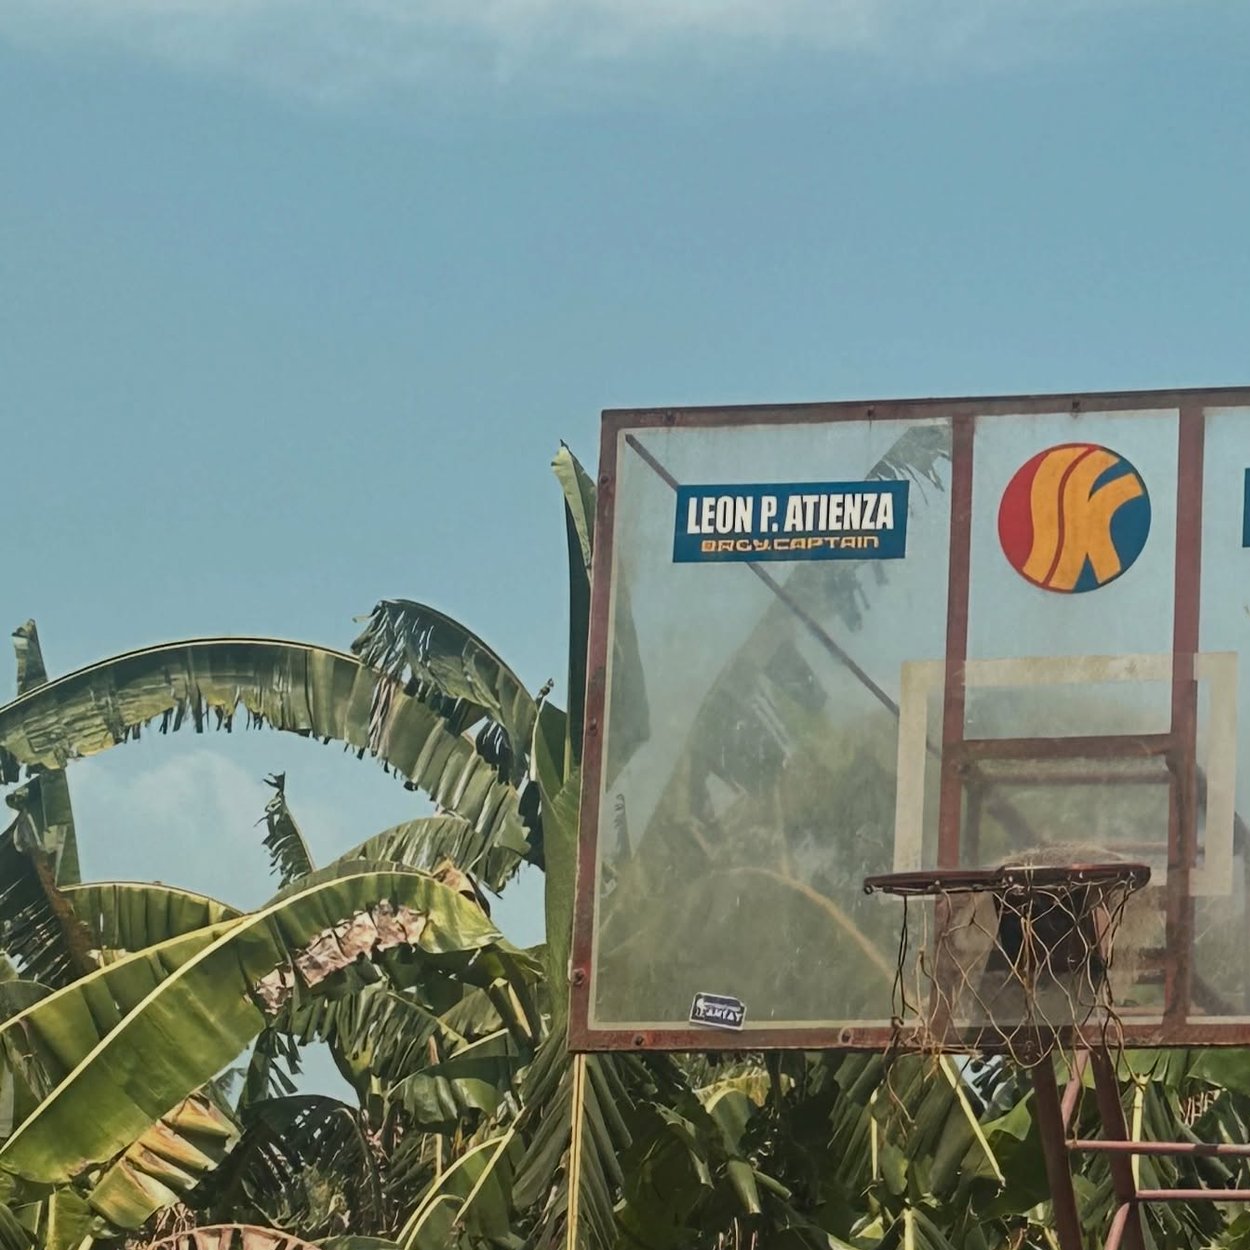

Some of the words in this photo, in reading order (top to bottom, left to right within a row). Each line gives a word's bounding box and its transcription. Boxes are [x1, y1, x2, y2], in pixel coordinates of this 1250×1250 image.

[686, 495, 753, 535] LEON
[759, 494, 778, 533] P.
[783, 492, 894, 532] ATIENZA
